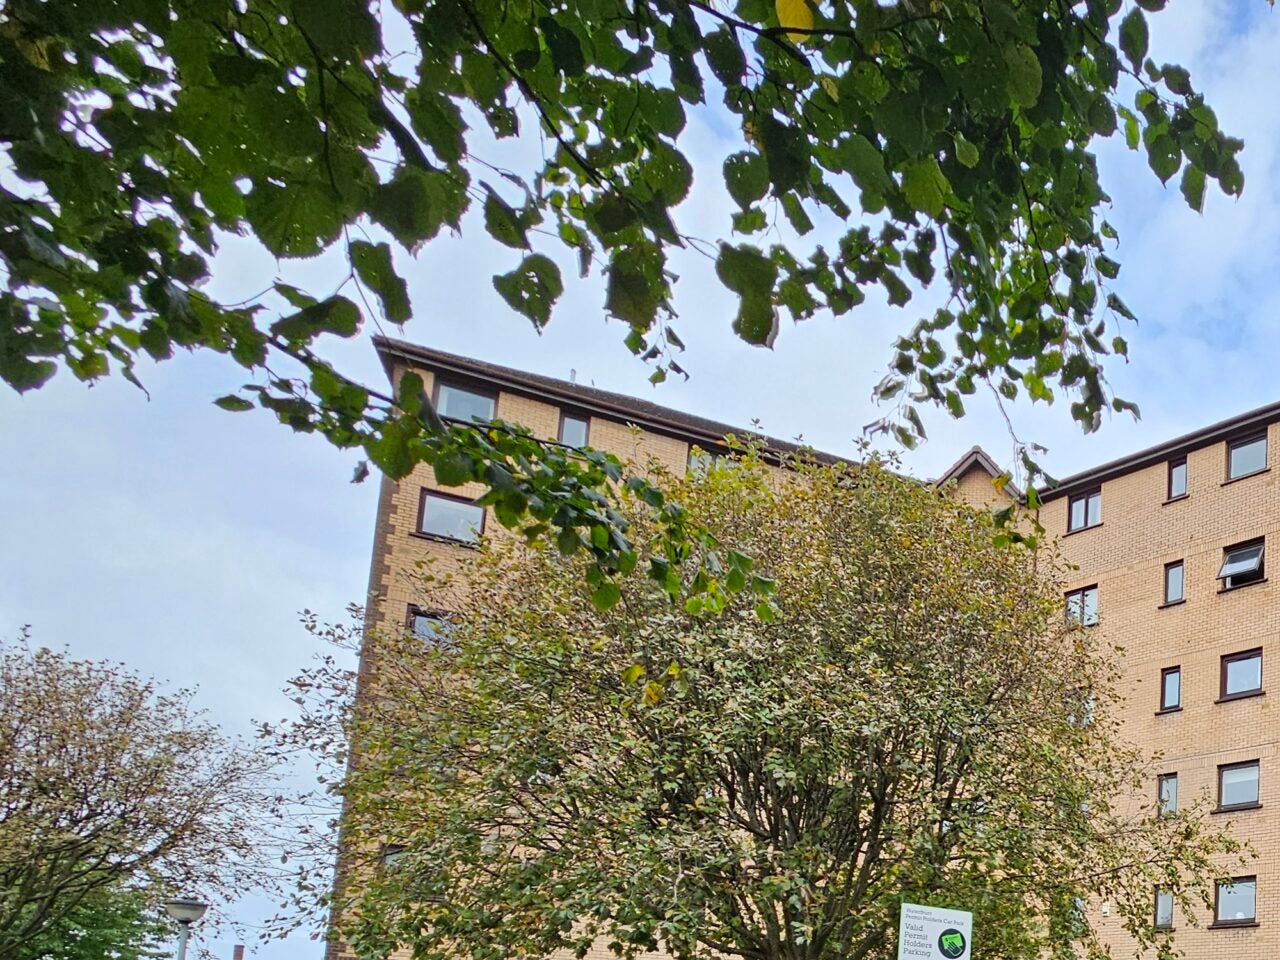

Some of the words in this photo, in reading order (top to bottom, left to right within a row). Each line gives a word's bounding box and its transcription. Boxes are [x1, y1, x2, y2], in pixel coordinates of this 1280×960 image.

[905, 923, 924, 932] Valid
[904, 931, 928, 940] Permit
[904, 940, 933, 949] Holders
[903, 948, 931, 958] Parking
